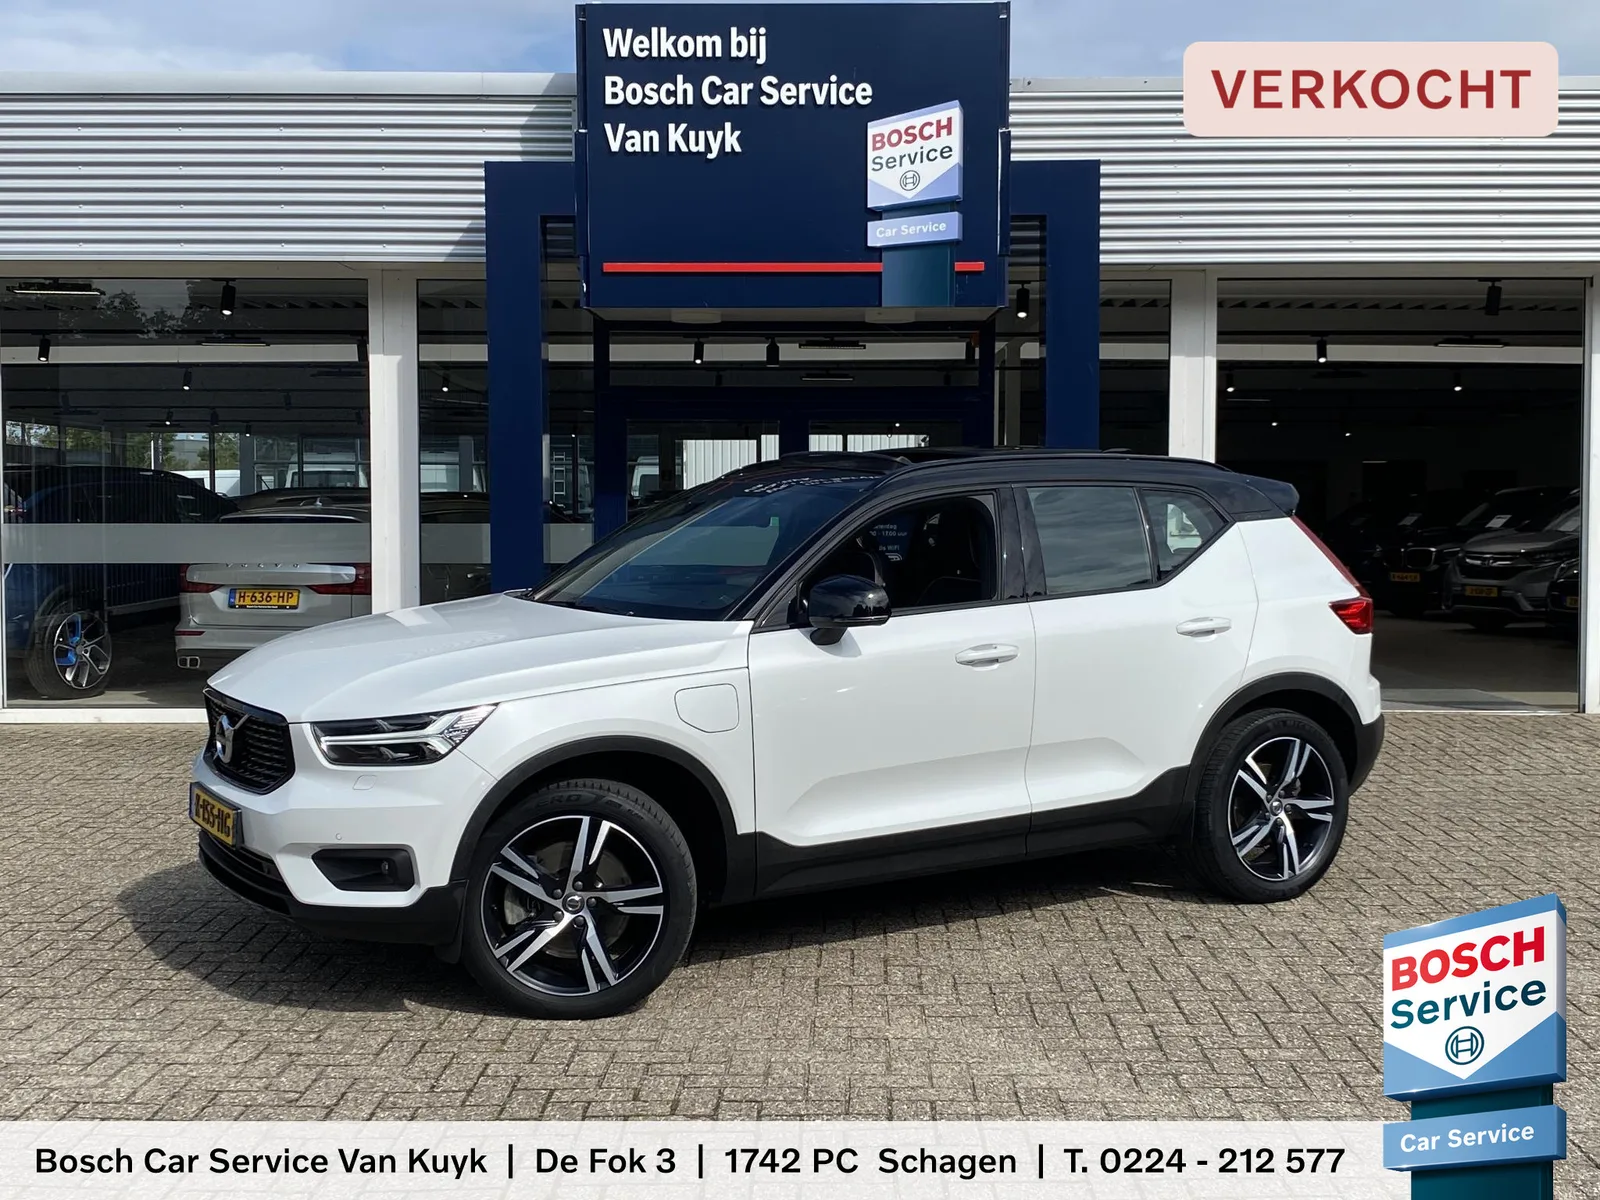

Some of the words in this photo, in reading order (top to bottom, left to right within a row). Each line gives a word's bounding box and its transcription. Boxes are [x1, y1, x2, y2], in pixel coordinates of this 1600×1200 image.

[602, 27, 722, 58] Welkom
[730, 27, 767, 65] bij
[603, 75, 694, 105] Bosch
[701, 75, 754, 105] Car
[760, 75, 873, 105] Service
[603, 123, 660, 153] Van
[668, 122, 742, 159] Kuyk
[872, 117, 953, 152] BOSCH
[871, 144, 953, 173] Service
[876, 225, 899, 239] Car
[900, 220, 947, 236] Service
[238, 591, 294, 604] H-636-HP
